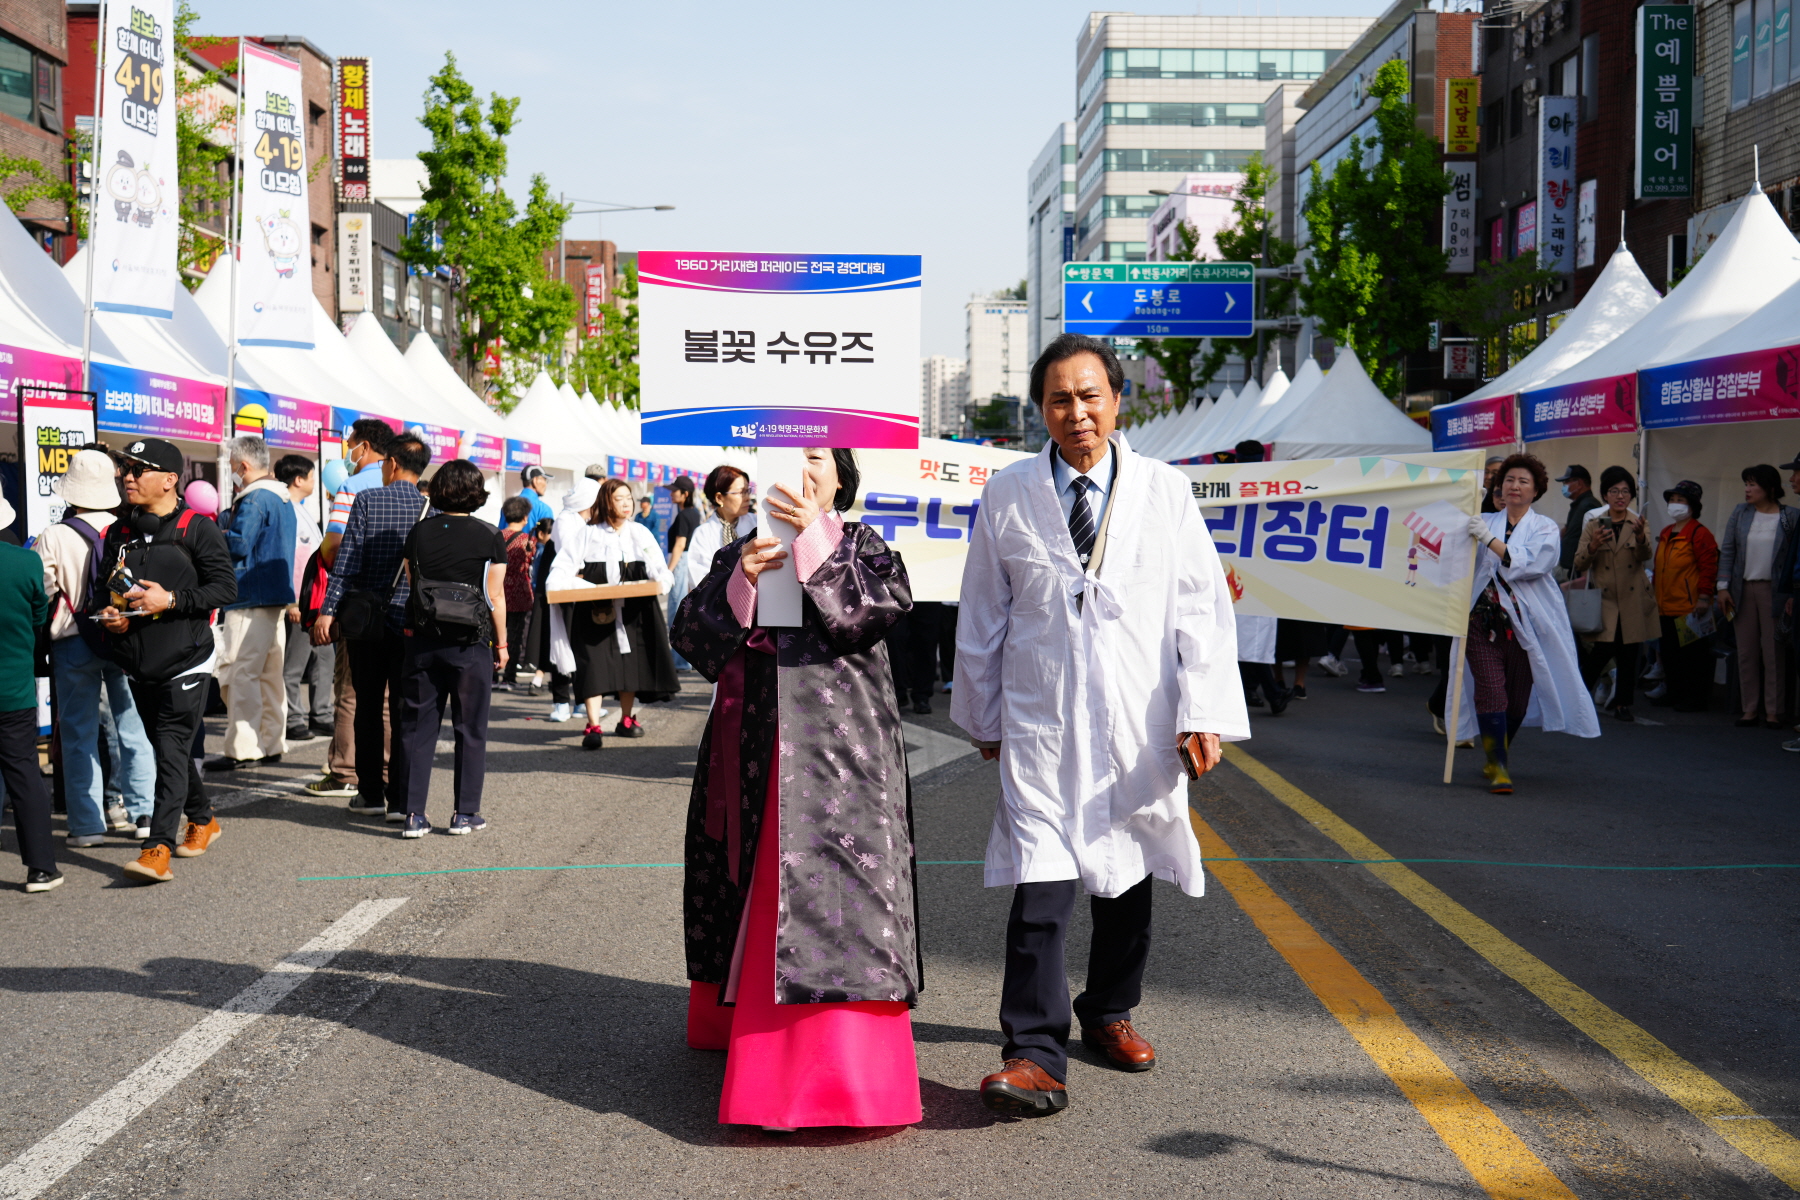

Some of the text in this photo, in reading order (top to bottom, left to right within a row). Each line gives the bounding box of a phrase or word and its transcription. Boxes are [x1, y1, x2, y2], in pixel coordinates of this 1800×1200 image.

[130, 6, 162, 40] 보보와
[1649, 14, 1688, 31] The
[118, 28, 139, 54] 함께
[116, 56, 162, 106] 4·19
[266, 91, 297, 117] 보보와
[1454, 87, 1471, 139] 전당포
[1653, 38, 1681, 171] 예쁨헤어
[256, 110, 276, 132] 함께
[255, 132, 302, 172] 4·19
[1547, 112, 1573, 210] 아리랑
[1453, 172, 1471, 202] 썸
[1450, 208, 1458, 258] 7080
[1459, 208, 1471, 258] 라이브
[1550, 213, 1566, 258] 노래방
[675, 259, 885, 275] 1960 거리재현 퍼레이드 전국 경연대회
[1142, 267, 1189, 280] 번동사거리
[1192, 267, 1239, 279] 수유사거리
[1133, 289, 1181, 306] 도봉로
[1147, 325, 1170, 333] 150m
[685, 330, 875, 365] 불꽃 수유즈
[1661, 370, 1762, 405] 합동상황실 경찰본부
[105, 389, 132, 413] 보보와
[133, 393, 150, 416] 함께
[151, 396, 175, 419] 떠나는
[1534, 393, 1606, 423] 합동상황실 소방본부
[37, 426, 85, 447] 보보와 함께
[759, 424, 829, 434] 4·19 혁명국민문화제
[920, 459, 960, 482] 맛도
[1191, 480, 1319, 498] 함께 즐겨요~
